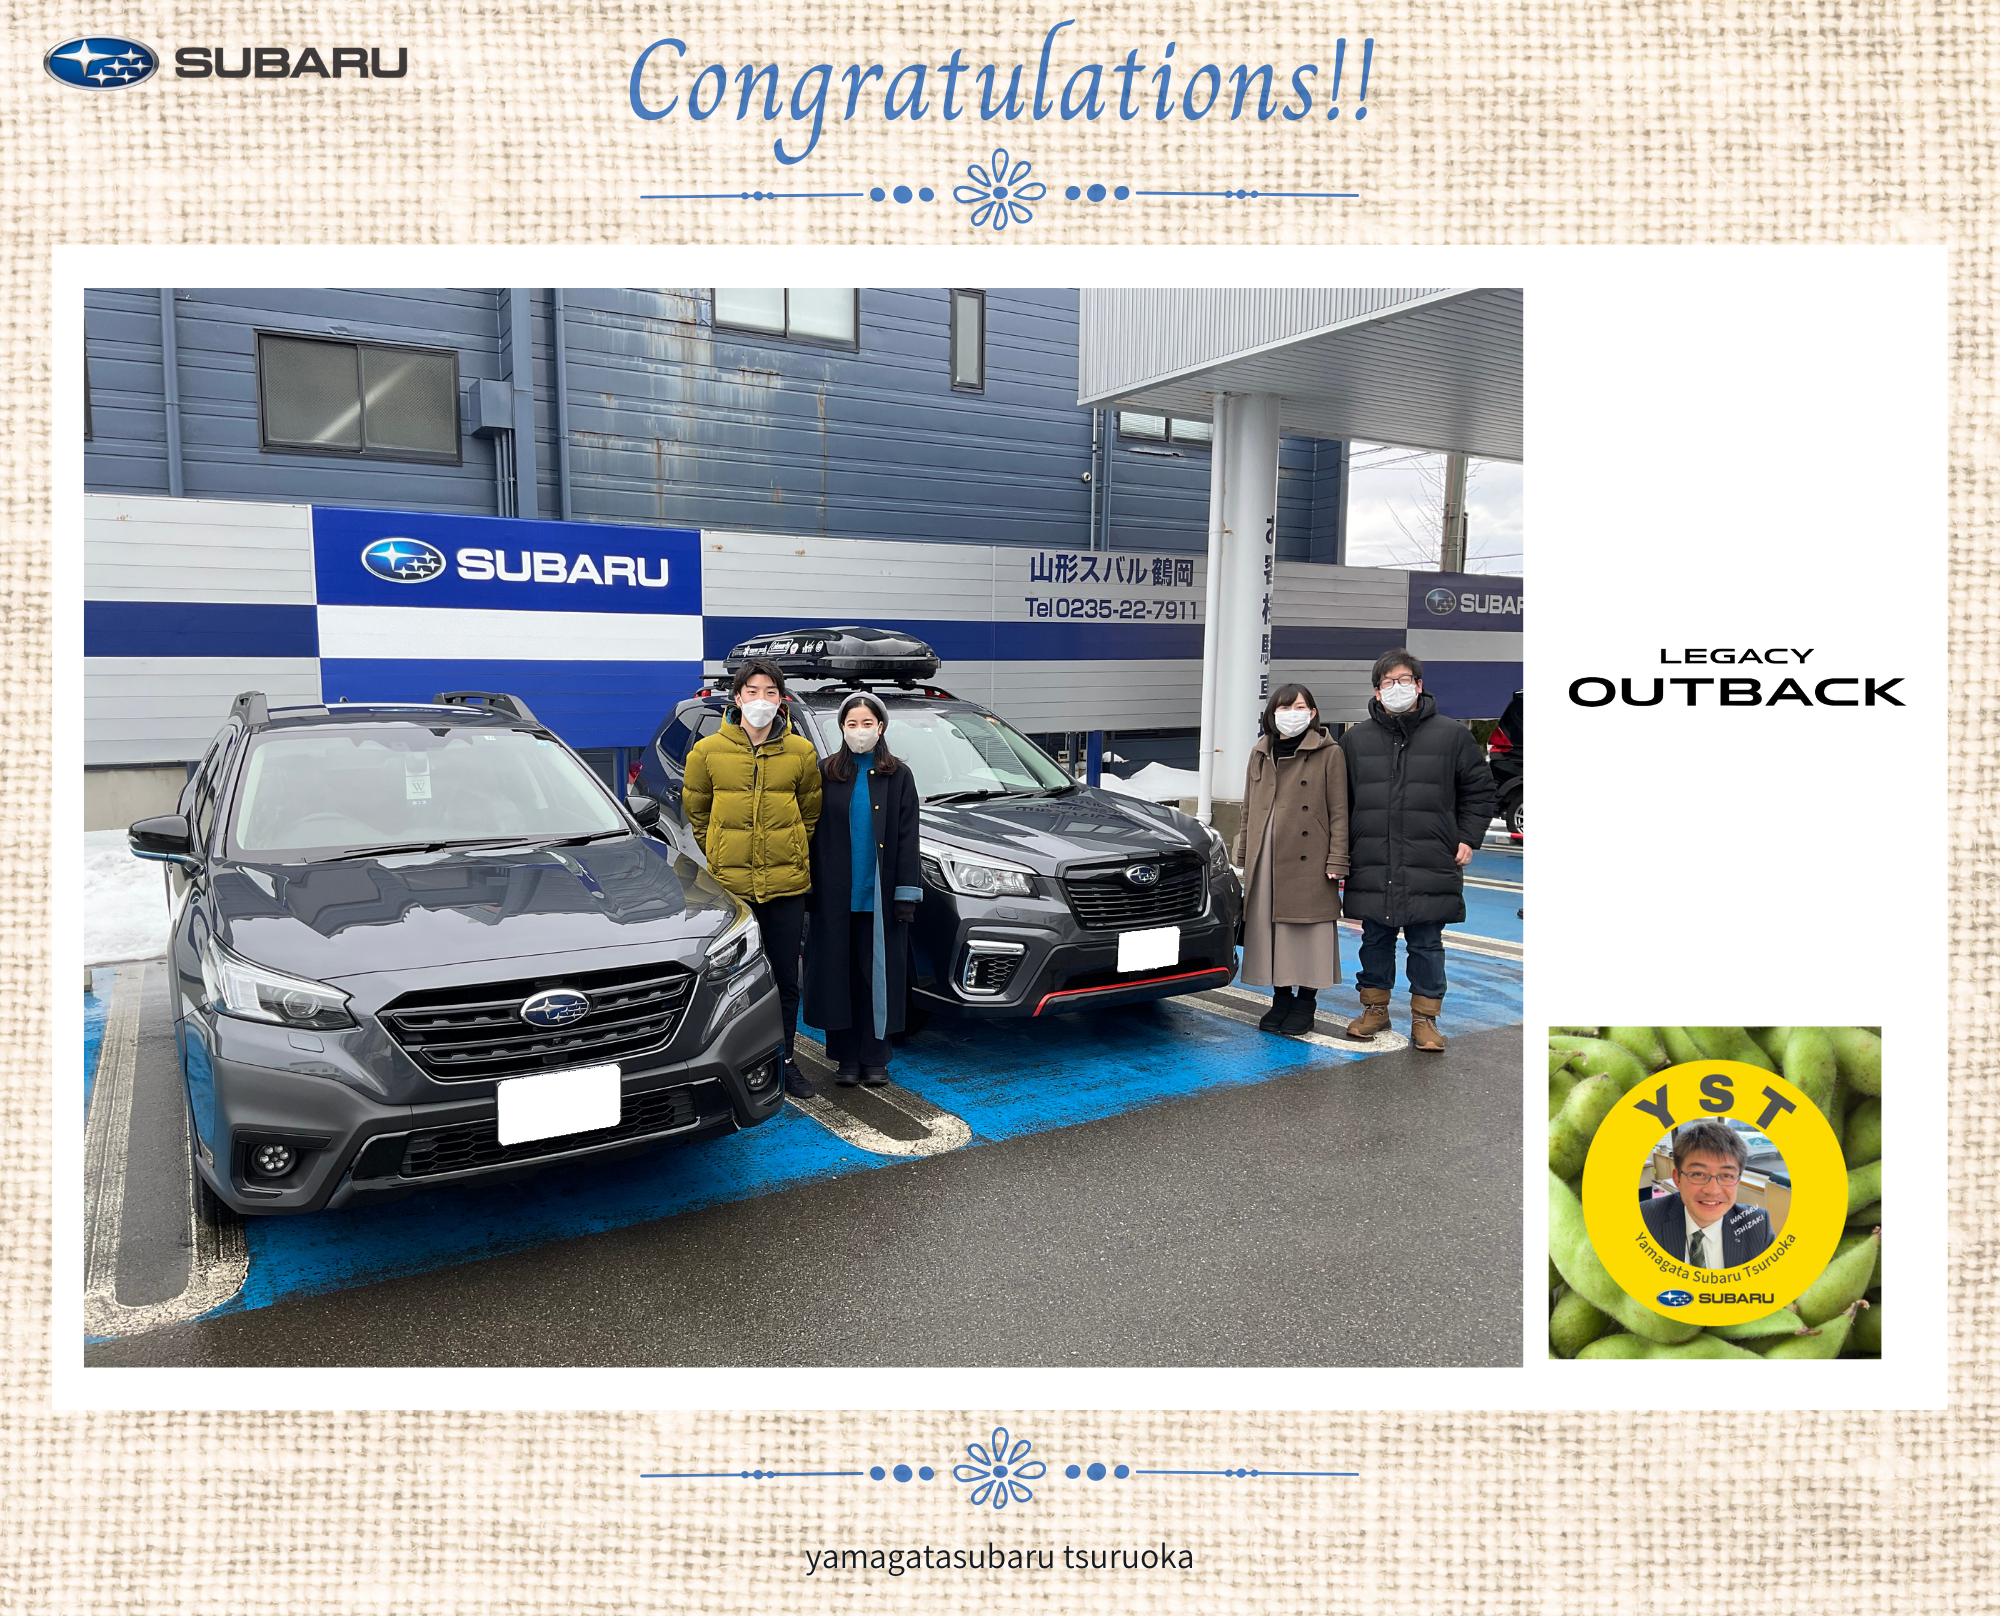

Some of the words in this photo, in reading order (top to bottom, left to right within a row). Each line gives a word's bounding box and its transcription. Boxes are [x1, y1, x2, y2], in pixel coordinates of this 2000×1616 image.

[456, 547, 669, 588] SUBARU
[1030, 552, 1194, 587] 山形スバル鶴岡
